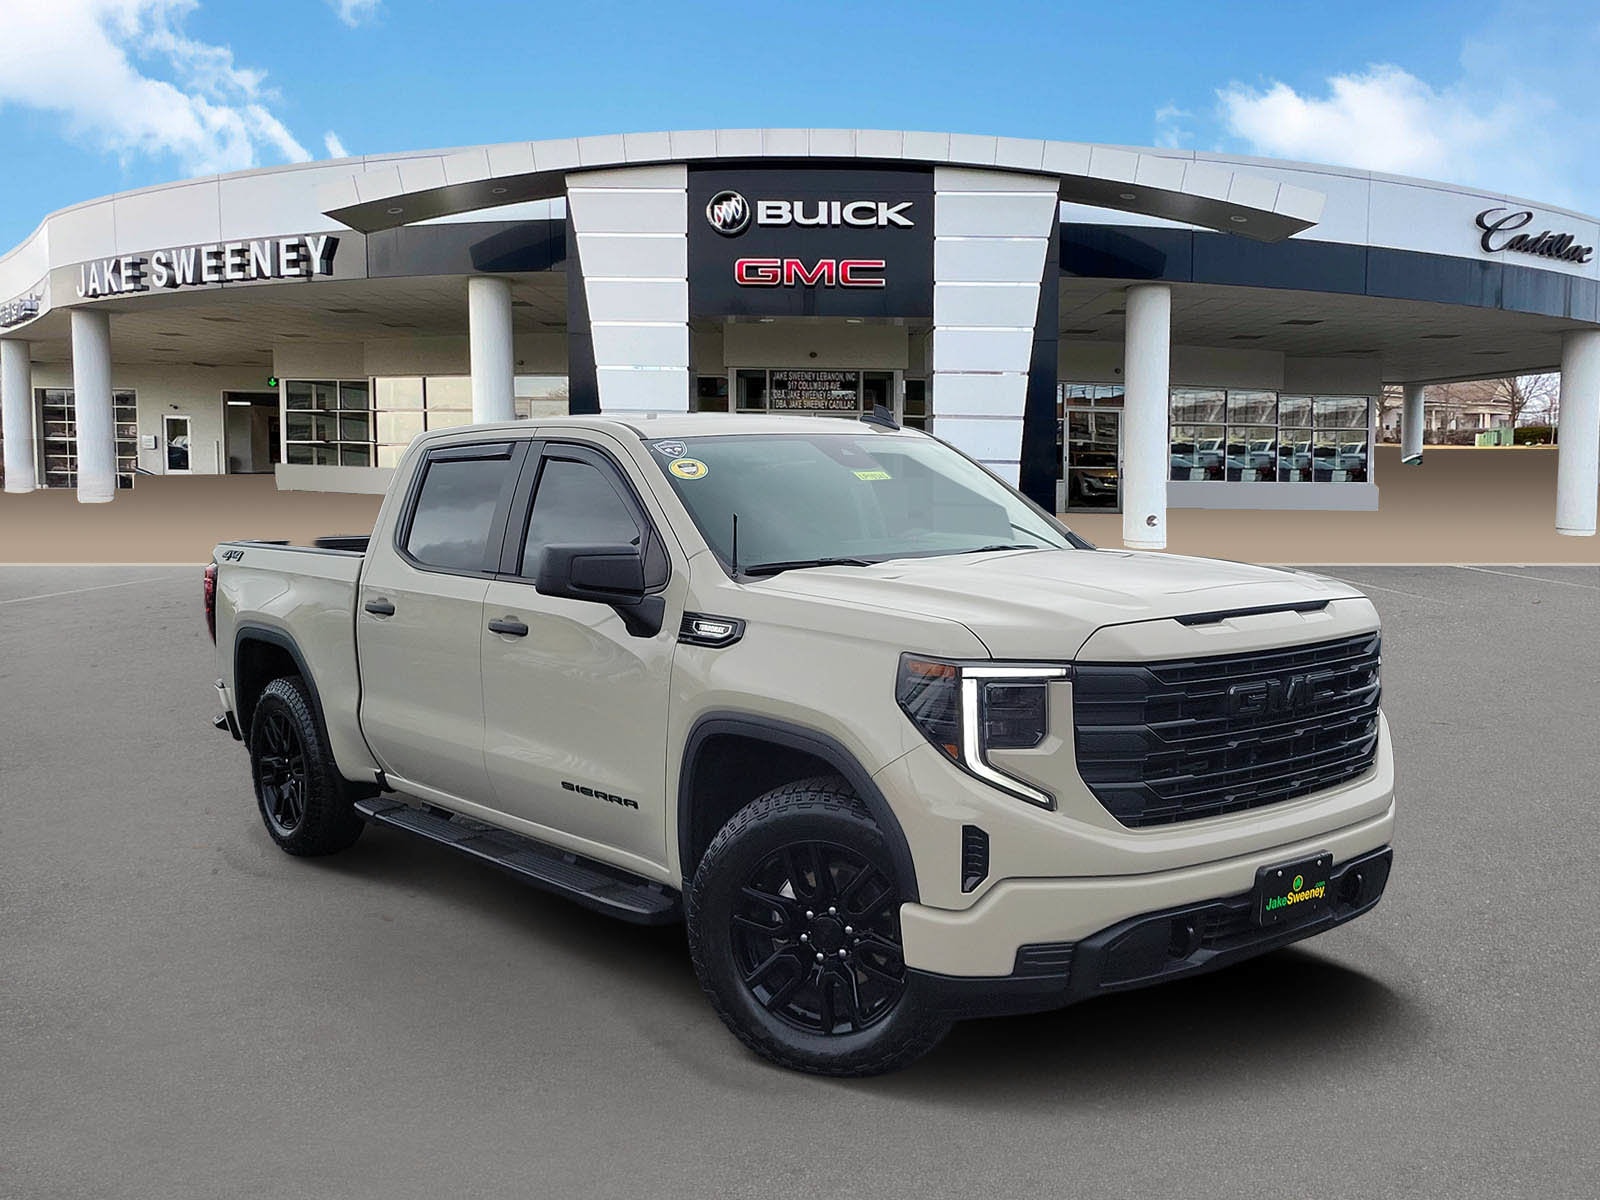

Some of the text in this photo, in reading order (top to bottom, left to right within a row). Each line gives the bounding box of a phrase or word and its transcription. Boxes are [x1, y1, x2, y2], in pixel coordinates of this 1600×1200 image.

[757, 200, 915, 226] BUICK
[1475, 207, 1593, 263] Cadillac
[76, 235, 334, 298] JAKE SWEENEY
[735, 258, 886, 287] GMC
[1226, 669, 1336, 715] GMC
[561, 781, 639, 810] SIERRA
